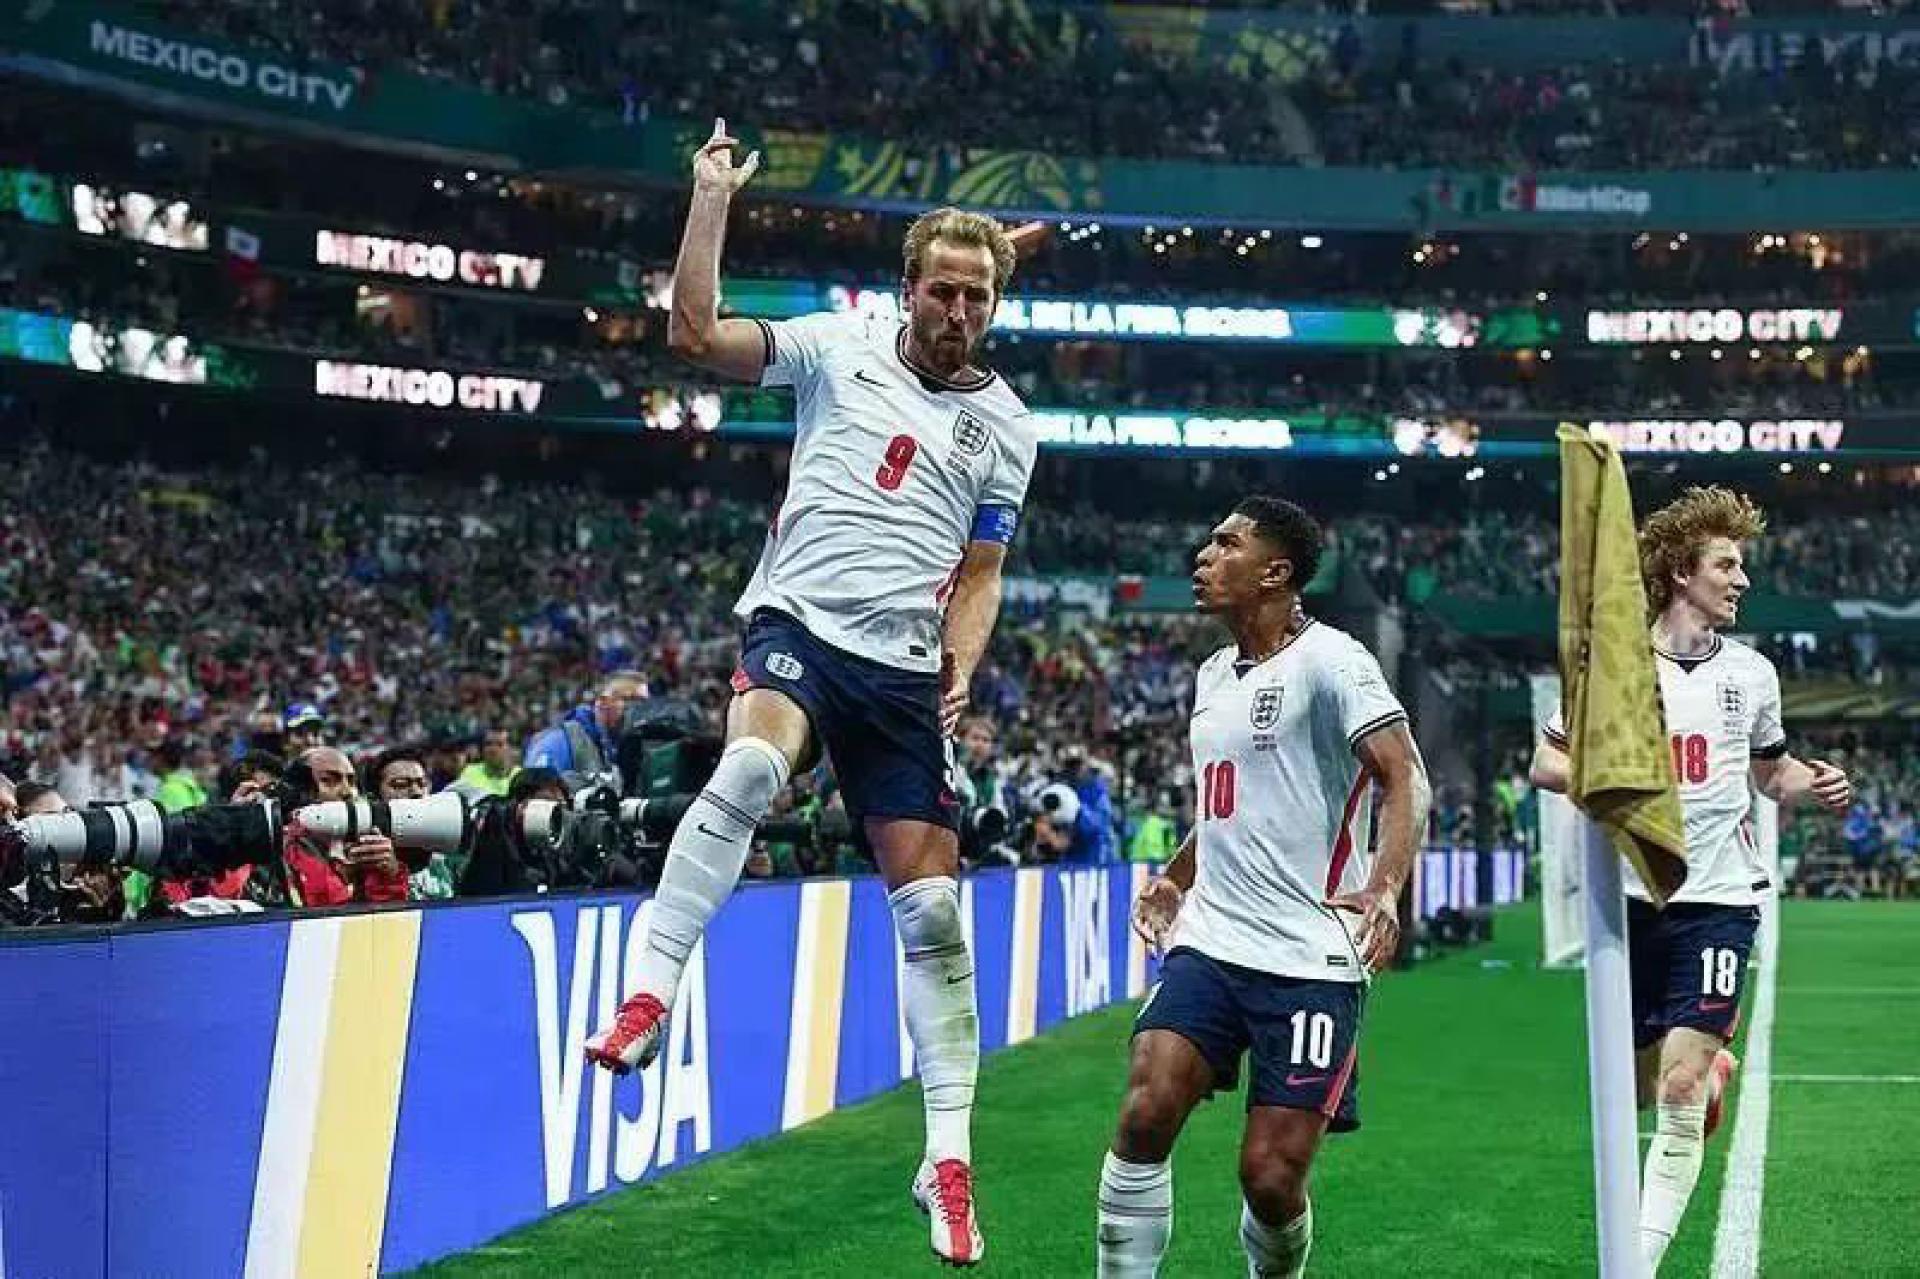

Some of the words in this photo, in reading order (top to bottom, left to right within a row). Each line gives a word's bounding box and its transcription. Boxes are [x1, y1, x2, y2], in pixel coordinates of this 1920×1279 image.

[90, 20, 250, 88] MEXICO
[256, 64, 352, 110] CITY
[316, 229, 456, 281] MEXICO
[1588, 310, 1744, 342] MEXICO
[1748, 308, 1843, 342] CITY
[316, 359, 454, 407] MEXICO
[457, 373, 544, 414] CITY
[875, 434, 918, 491] 9
[1748, 419, 1844, 451] CITY
[1671, 733, 1708, 785] 18
[1204, 760, 1236, 820] 10
[1058, 868, 1112, 1019] VISA
[1701, 947, 1739, 997] 18
[510, 899, 712, 1210] VISA
[1290, 1010, 1334, 1069] 10
